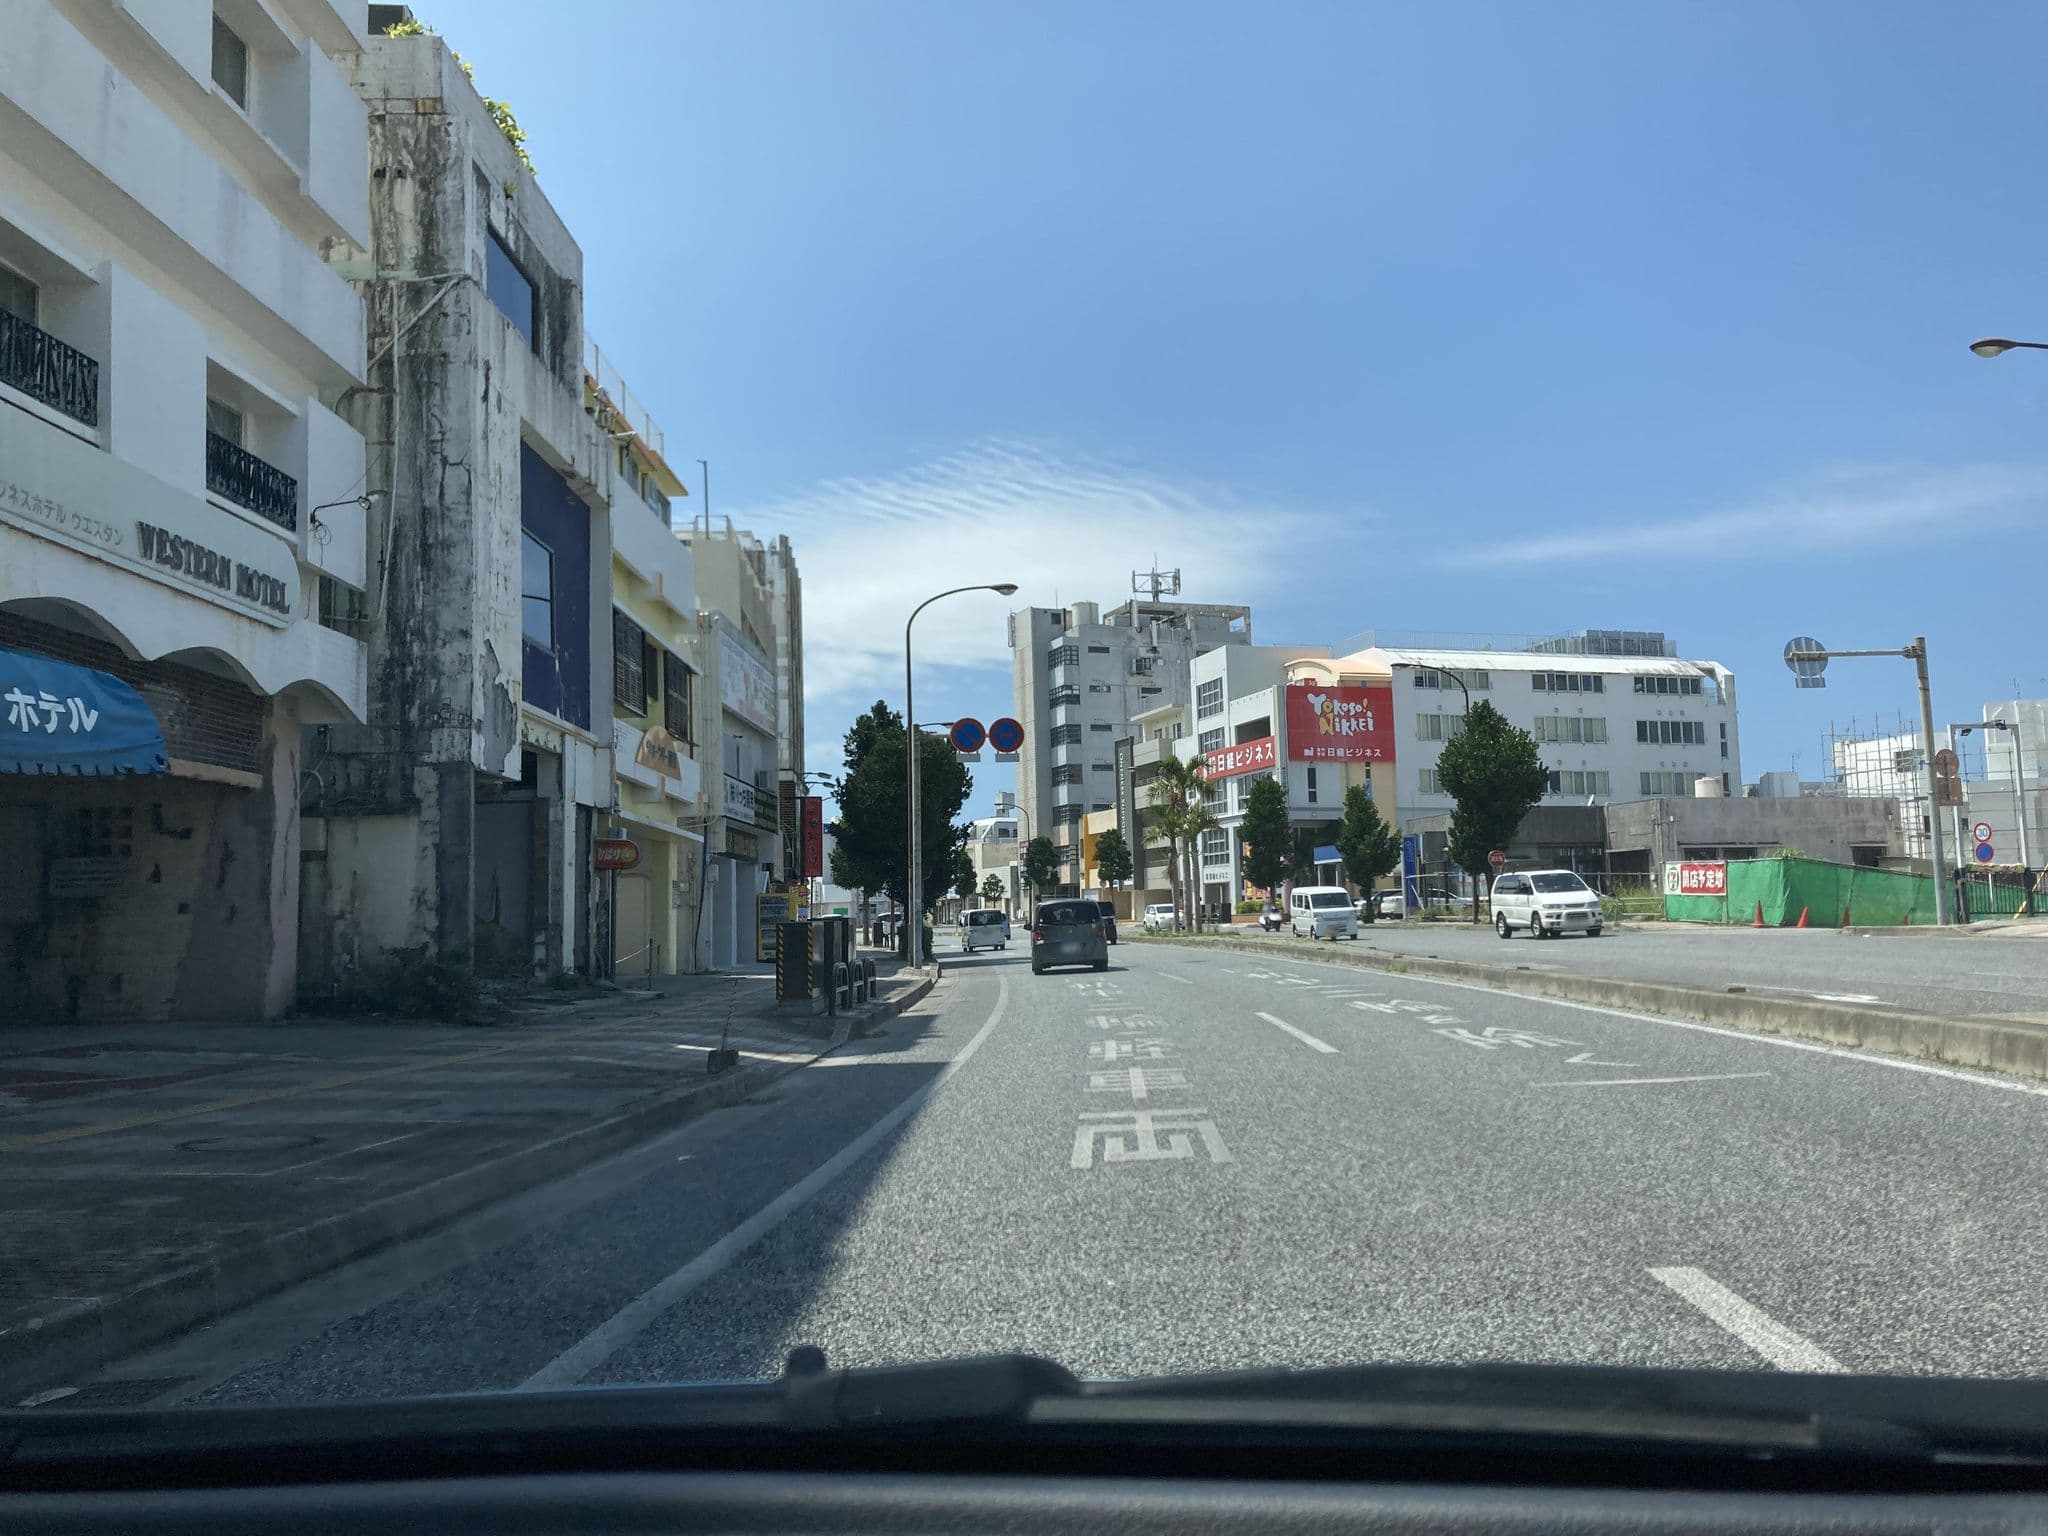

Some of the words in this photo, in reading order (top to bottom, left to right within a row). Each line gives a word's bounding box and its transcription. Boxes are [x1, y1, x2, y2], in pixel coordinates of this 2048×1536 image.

[136, 520, 232, 592] WESTERN
[4, 686, 99, 735] ホテル
[1977, 827, 1988, 838] 30
